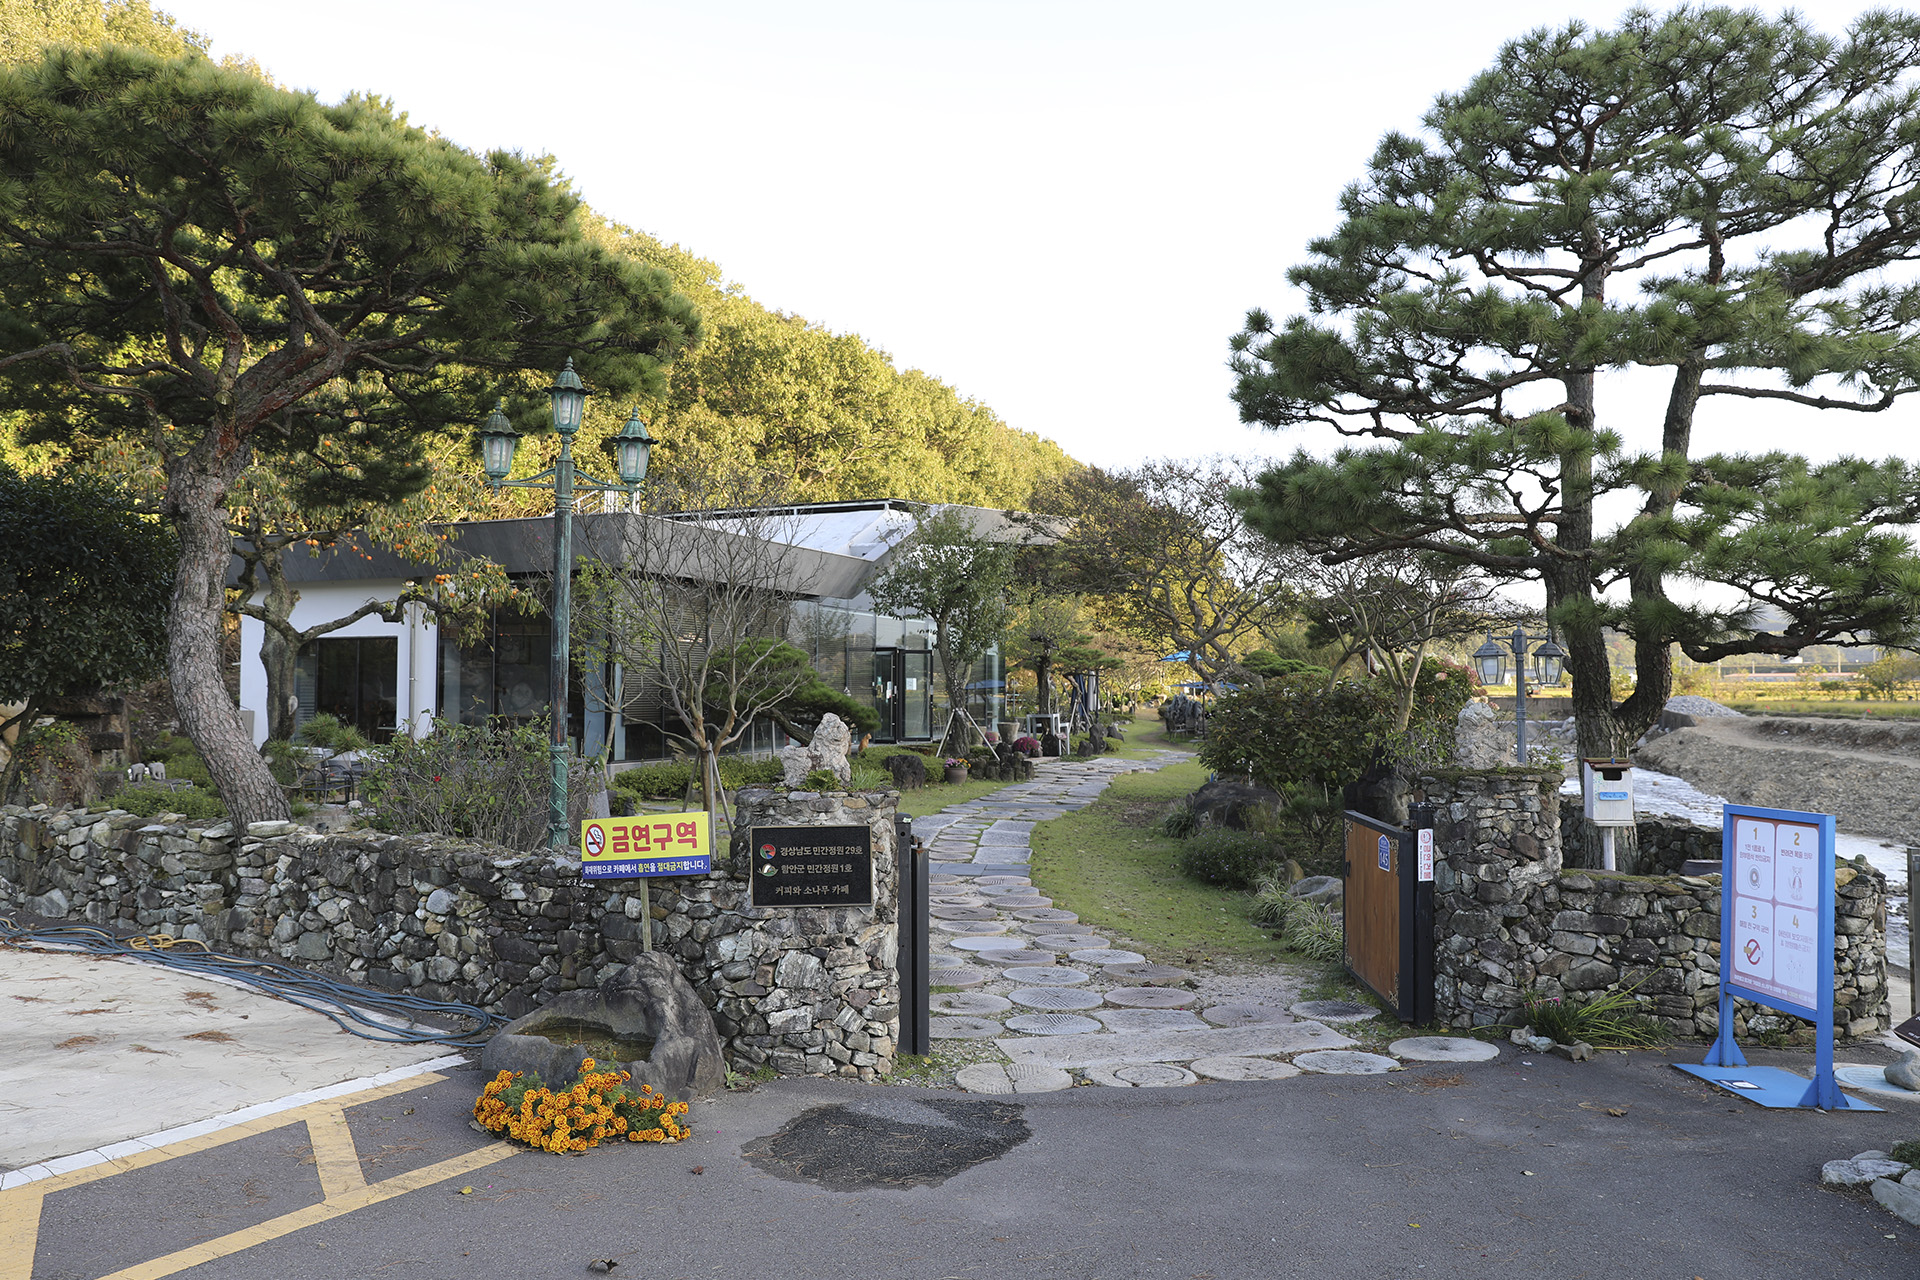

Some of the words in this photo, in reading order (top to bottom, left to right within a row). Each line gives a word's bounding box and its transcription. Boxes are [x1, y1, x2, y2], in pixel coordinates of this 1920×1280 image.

[612, 821, 698, 853] 금연구역
[1753, 827, 1758, 840] 1
[1794, 832, 1800, 846] 2
[780, 845, 812, 857] 경상남도
[812, 845, 844, 856] 민간정원
[845, 845, 863, 855] 29호
[1379, 851, 1389, 866] 145
[1423, 845, 1432, 879] 금연건물
[613, 863, 638, 874] 카페에서
[638, 862, 656, 873] 흡연을
[781, 864, 805, 875] 함안군
[806, 863, 839, 874] 민간정원
[840, 863, 853, 873] 1호
[775, 885, 801, 896] 커피와
[803, 885, 830, 896] 소나무
[831, 884, 850, 895] 카페
[1751, 905, 1757, 919] 3
[1793, 914, 1799, 928] 4
